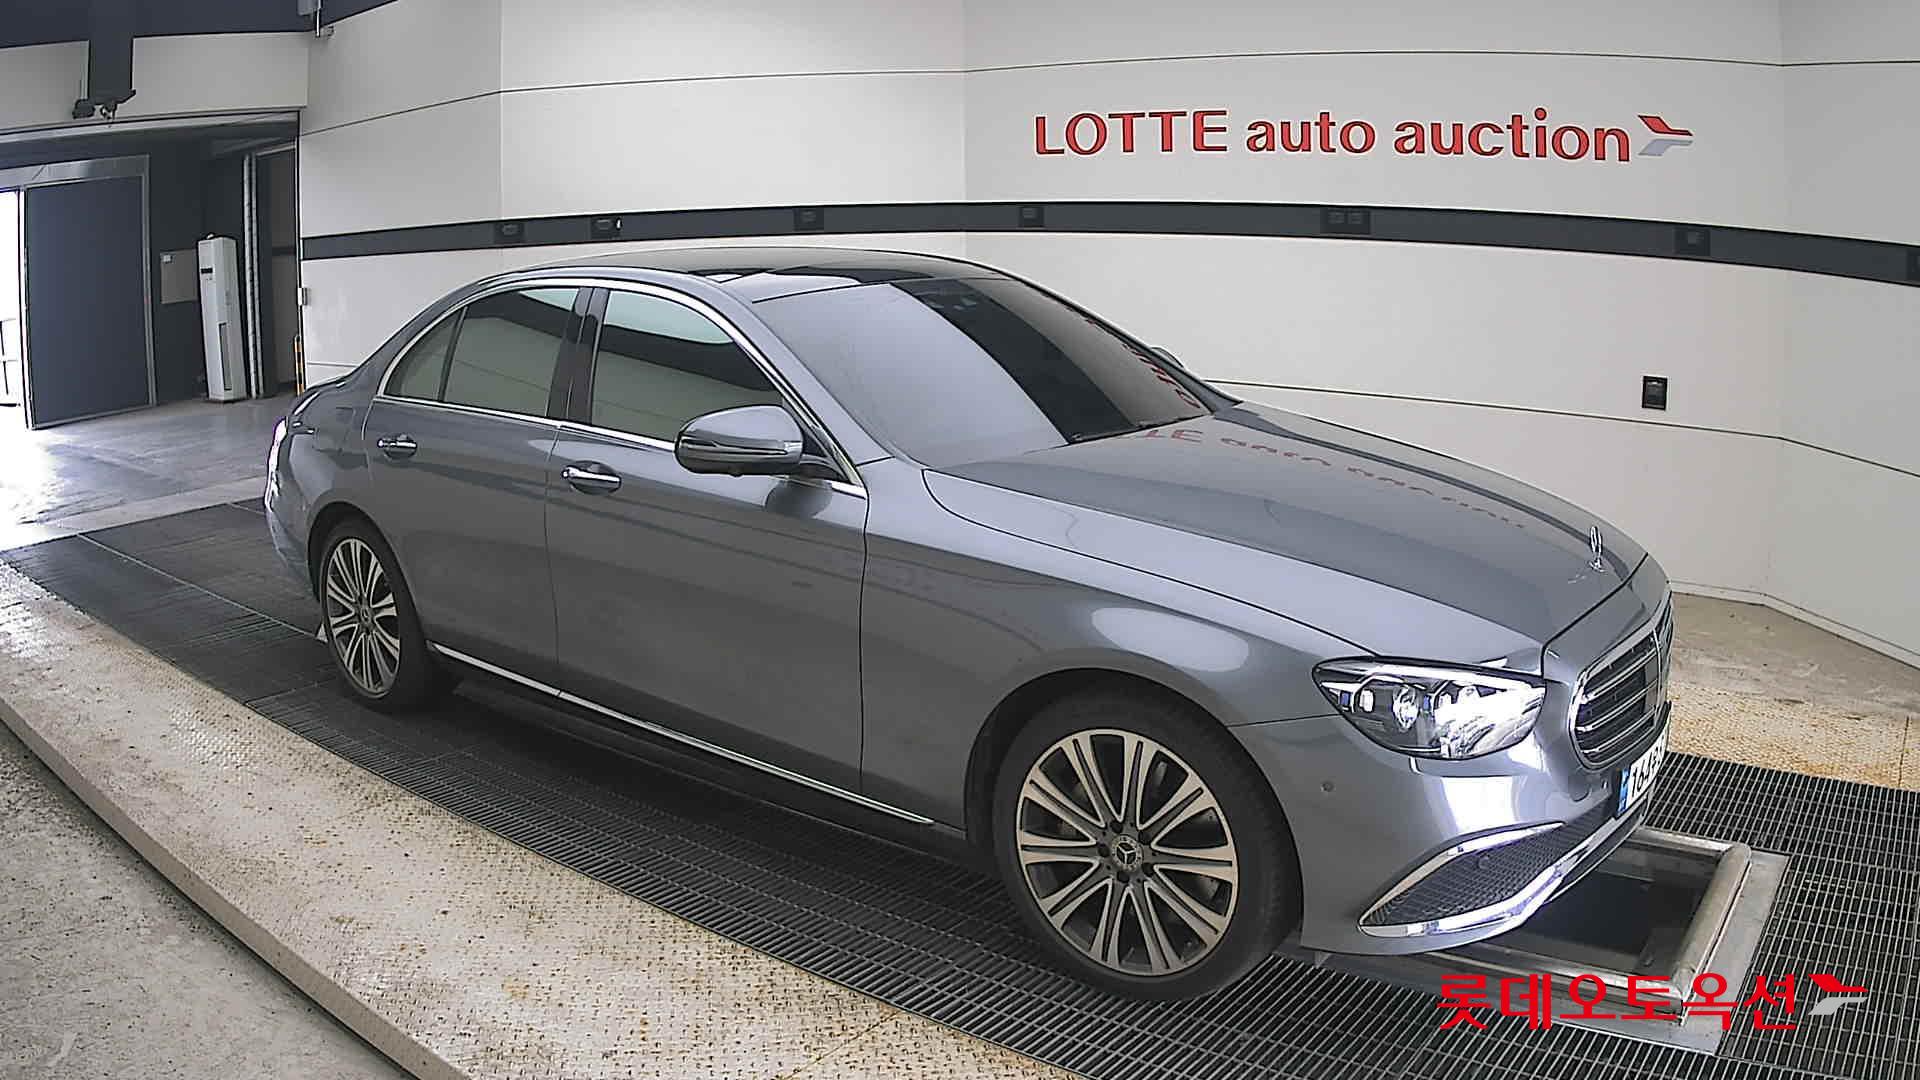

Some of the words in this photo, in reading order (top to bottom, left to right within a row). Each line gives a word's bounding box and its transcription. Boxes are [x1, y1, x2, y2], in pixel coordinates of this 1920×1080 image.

[1035, 109, 1228, 156] LOTTE
[1246, 111, 1377, 154] auto
[1394, 107, 1630, 162] auction
